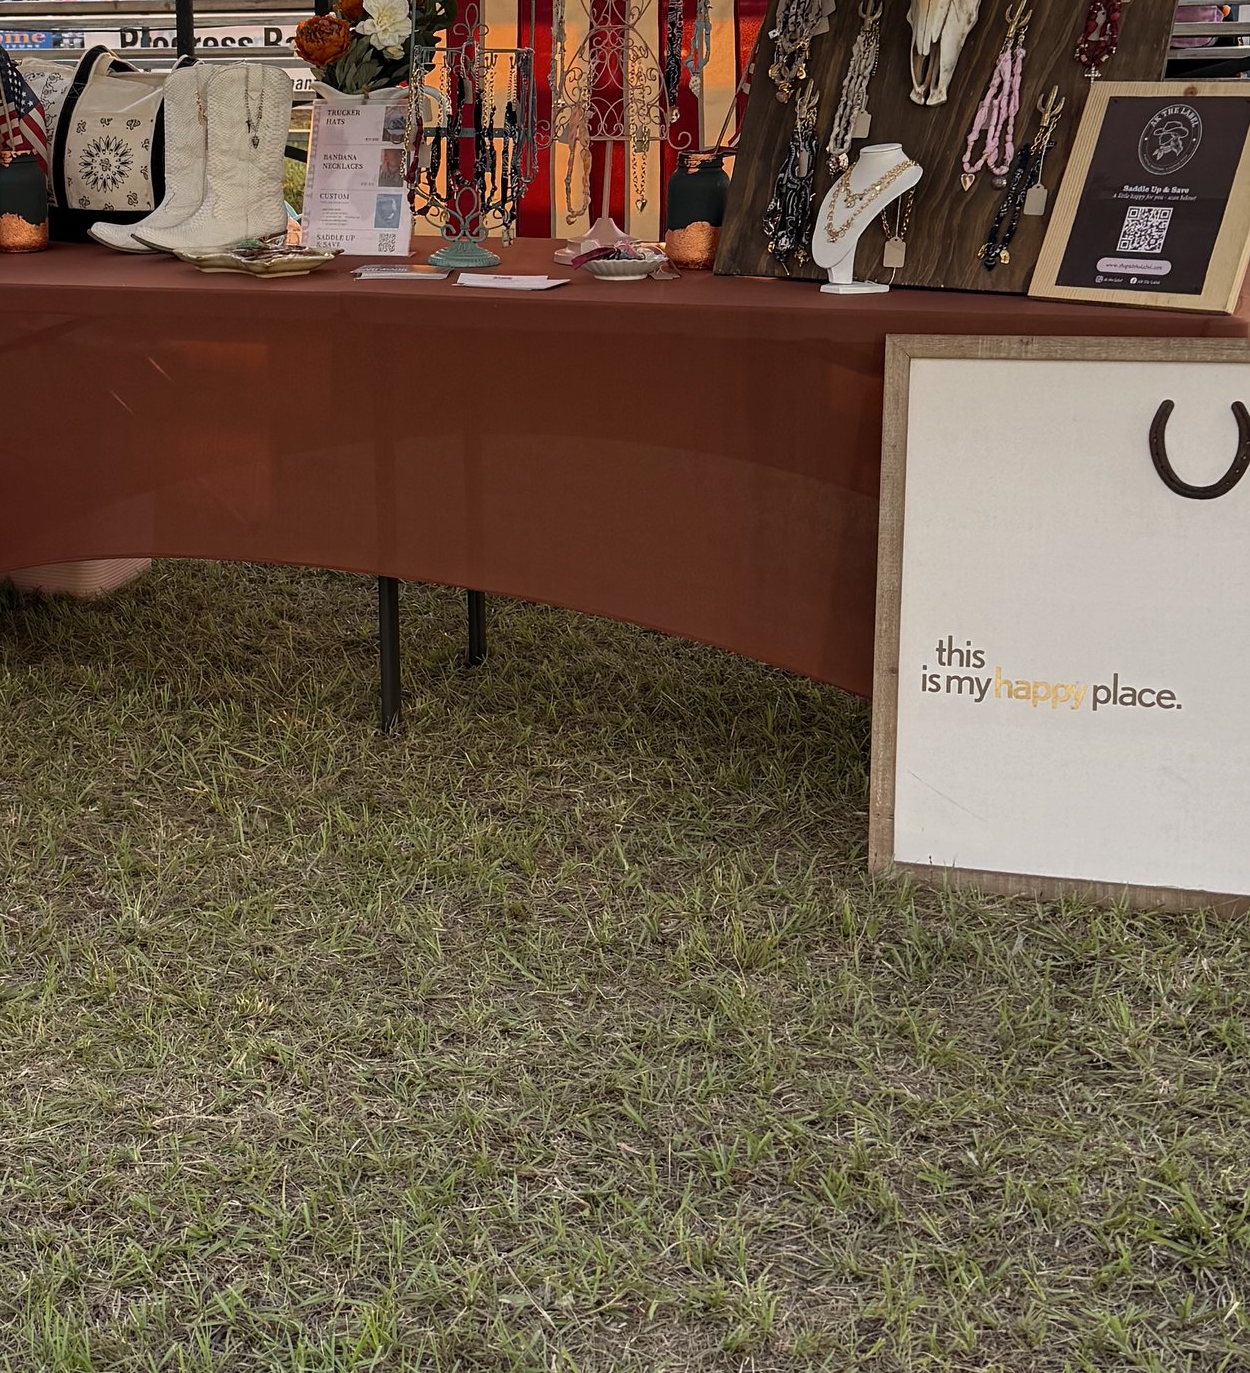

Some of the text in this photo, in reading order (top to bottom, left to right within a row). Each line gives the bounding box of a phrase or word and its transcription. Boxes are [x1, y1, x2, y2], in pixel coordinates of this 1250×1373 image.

[120, 28, 254, 48] Poress
[1150, 107, 1199, 128] AK THE LABEL
[1123, 185, 1149, 193] Saddle
[1151, 186, 1162, 194] Up
[936, 635, 985, 668] this
[921, 665, 1182, 711] is my happy place.
